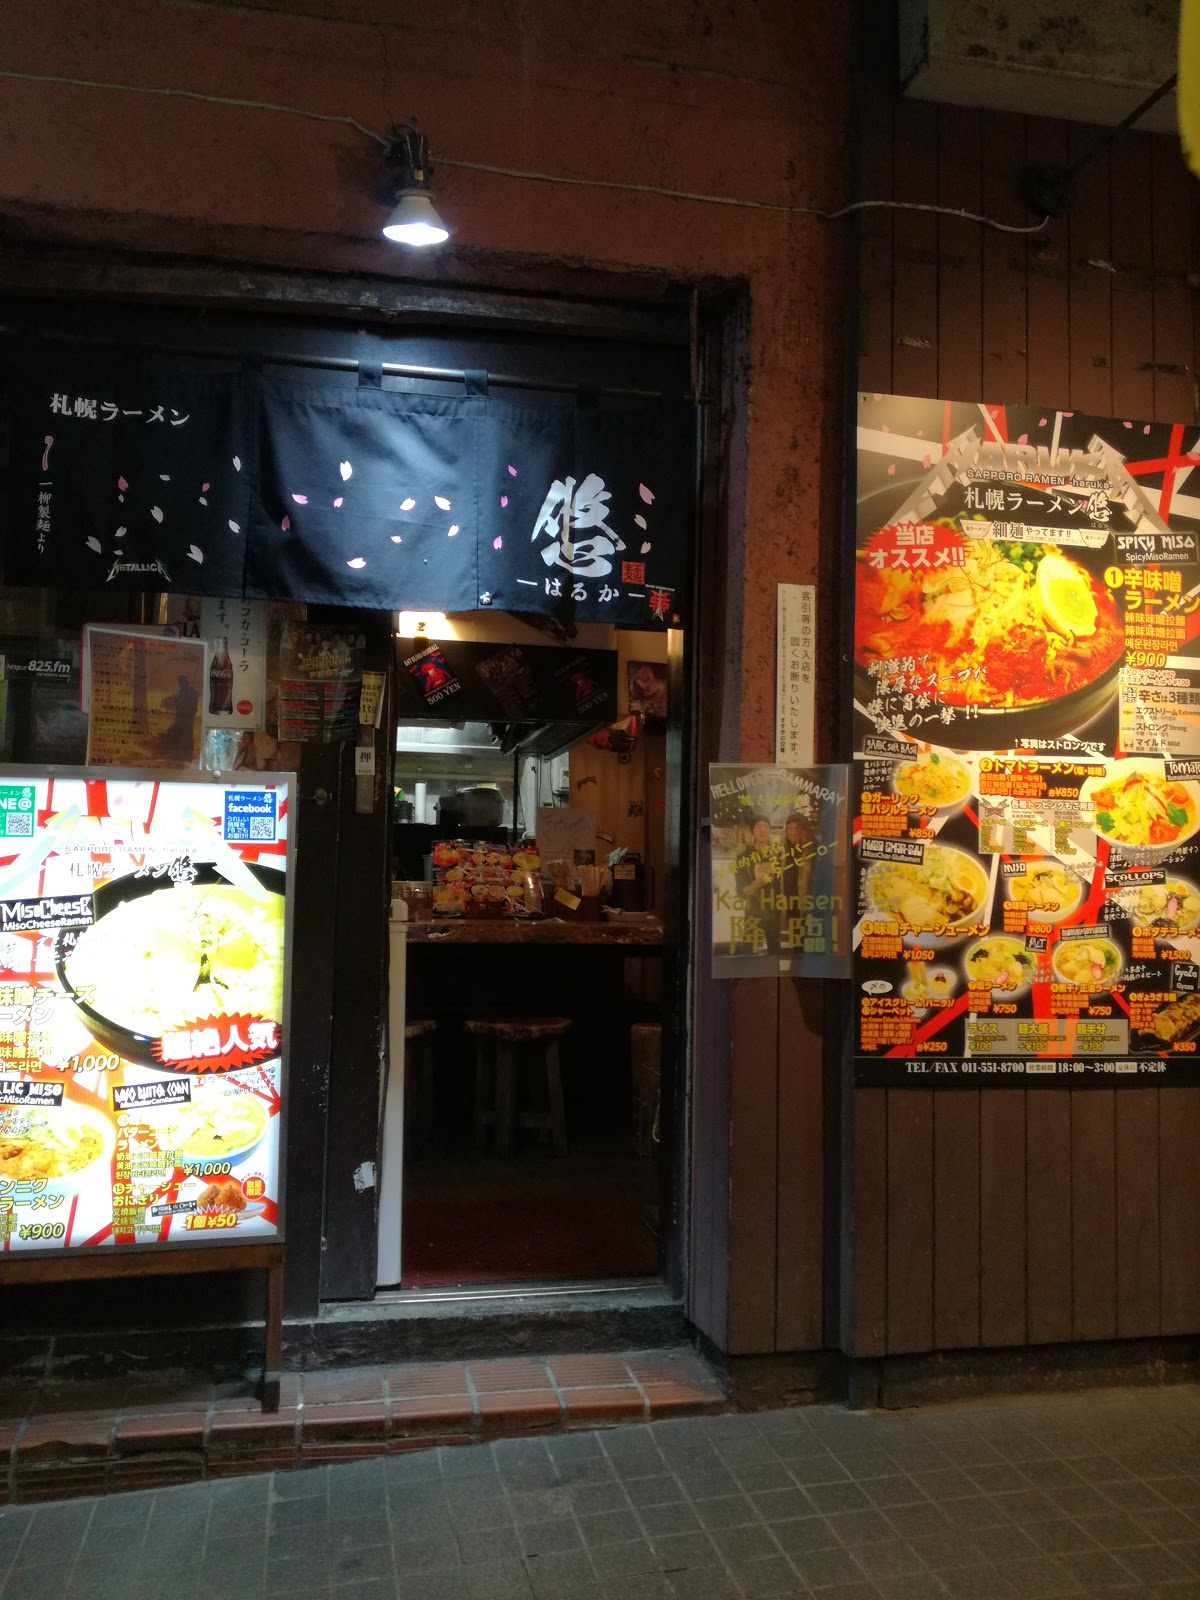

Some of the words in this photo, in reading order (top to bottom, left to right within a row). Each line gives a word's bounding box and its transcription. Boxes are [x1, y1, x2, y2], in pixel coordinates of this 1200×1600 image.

[49, 393, 190, 426] 札幌ラーメン
[966, 469, 1022, 483] SAPPORO
[1023, 474, 1065, 487] RAMEN
[896, 523, 935, 547] 当店
[1116, 534, 1156, 551] SPICY
[868, 545, 966, 570] オススメ!!
[1125, 550, 1190, 564] SpicyMisoRamen
[105, 558, 172, 582] METALLICA
[1125, 590, 1200, 614] ラーメン
[801, 591, 812, 683] 客引等の方入店を
[1126, 651, 1167, 668] ¥900
[426, 693, 444, 706] 500
[442, 681, 461, 697] YEN
[789, 636, 800, 755] 固くお断りいたします。
[576, 700, 593, 715] 500
[1135, 706, 1178, 717] エクストリーム
[1135, 722, 1169, 733] ストロング
[1169, 724, 1188, 733] Strong
[1020, 738, 1106, 753] 写真はストロングです
[1135, 738, 1167, 748] マイルド
[1167, 740, 1181, 748] Mild
[228, 802, 272, 814] facebook
[861, 803, 938, 817] 塩バジルラーメン
[909, 829, 936, 839] ¥850
[65, 845, 116, 854] SAPPORO
[1105, 871, 1165, 883] SCALLOPS
[760, 887, 844, 912] Hansen
[3, 916, 94, 932] MisoCheeseRamen
[1029, 924, 1053, 935] ¥800
[902, 950, 935, 961] ¥1,050
[1160, 949, 1191, 961] ¥1,500
[992, 1003, 1018, 1015] ¥750
[1088, 1006, 1113, 1017] ¥750
[968, 1023, 999, 1034] ライス
[969, 1042, 993, 1052] ¥100
[1018, 1042, 1048, 1052] +¥100
[1078, 1042, 1105, 1052] -¥100
[1173, 1042, 1197, 1053] ¥350
[56, 1054, 120, 1074] ¥1,000
[905, 1062, 957, 1074] TEL/FAX
[961, 1062, 1024, 1074] 011-551-8700
[1138, 1062, 1166, 1073] 不定休
[28, 1083, 63, 1097] MISO
[183, 1161, 231, 1176] ¥1,000
[112, 1194, 160, 1207] おにぎり
[19, 1221, 65, 1241] ¥900
